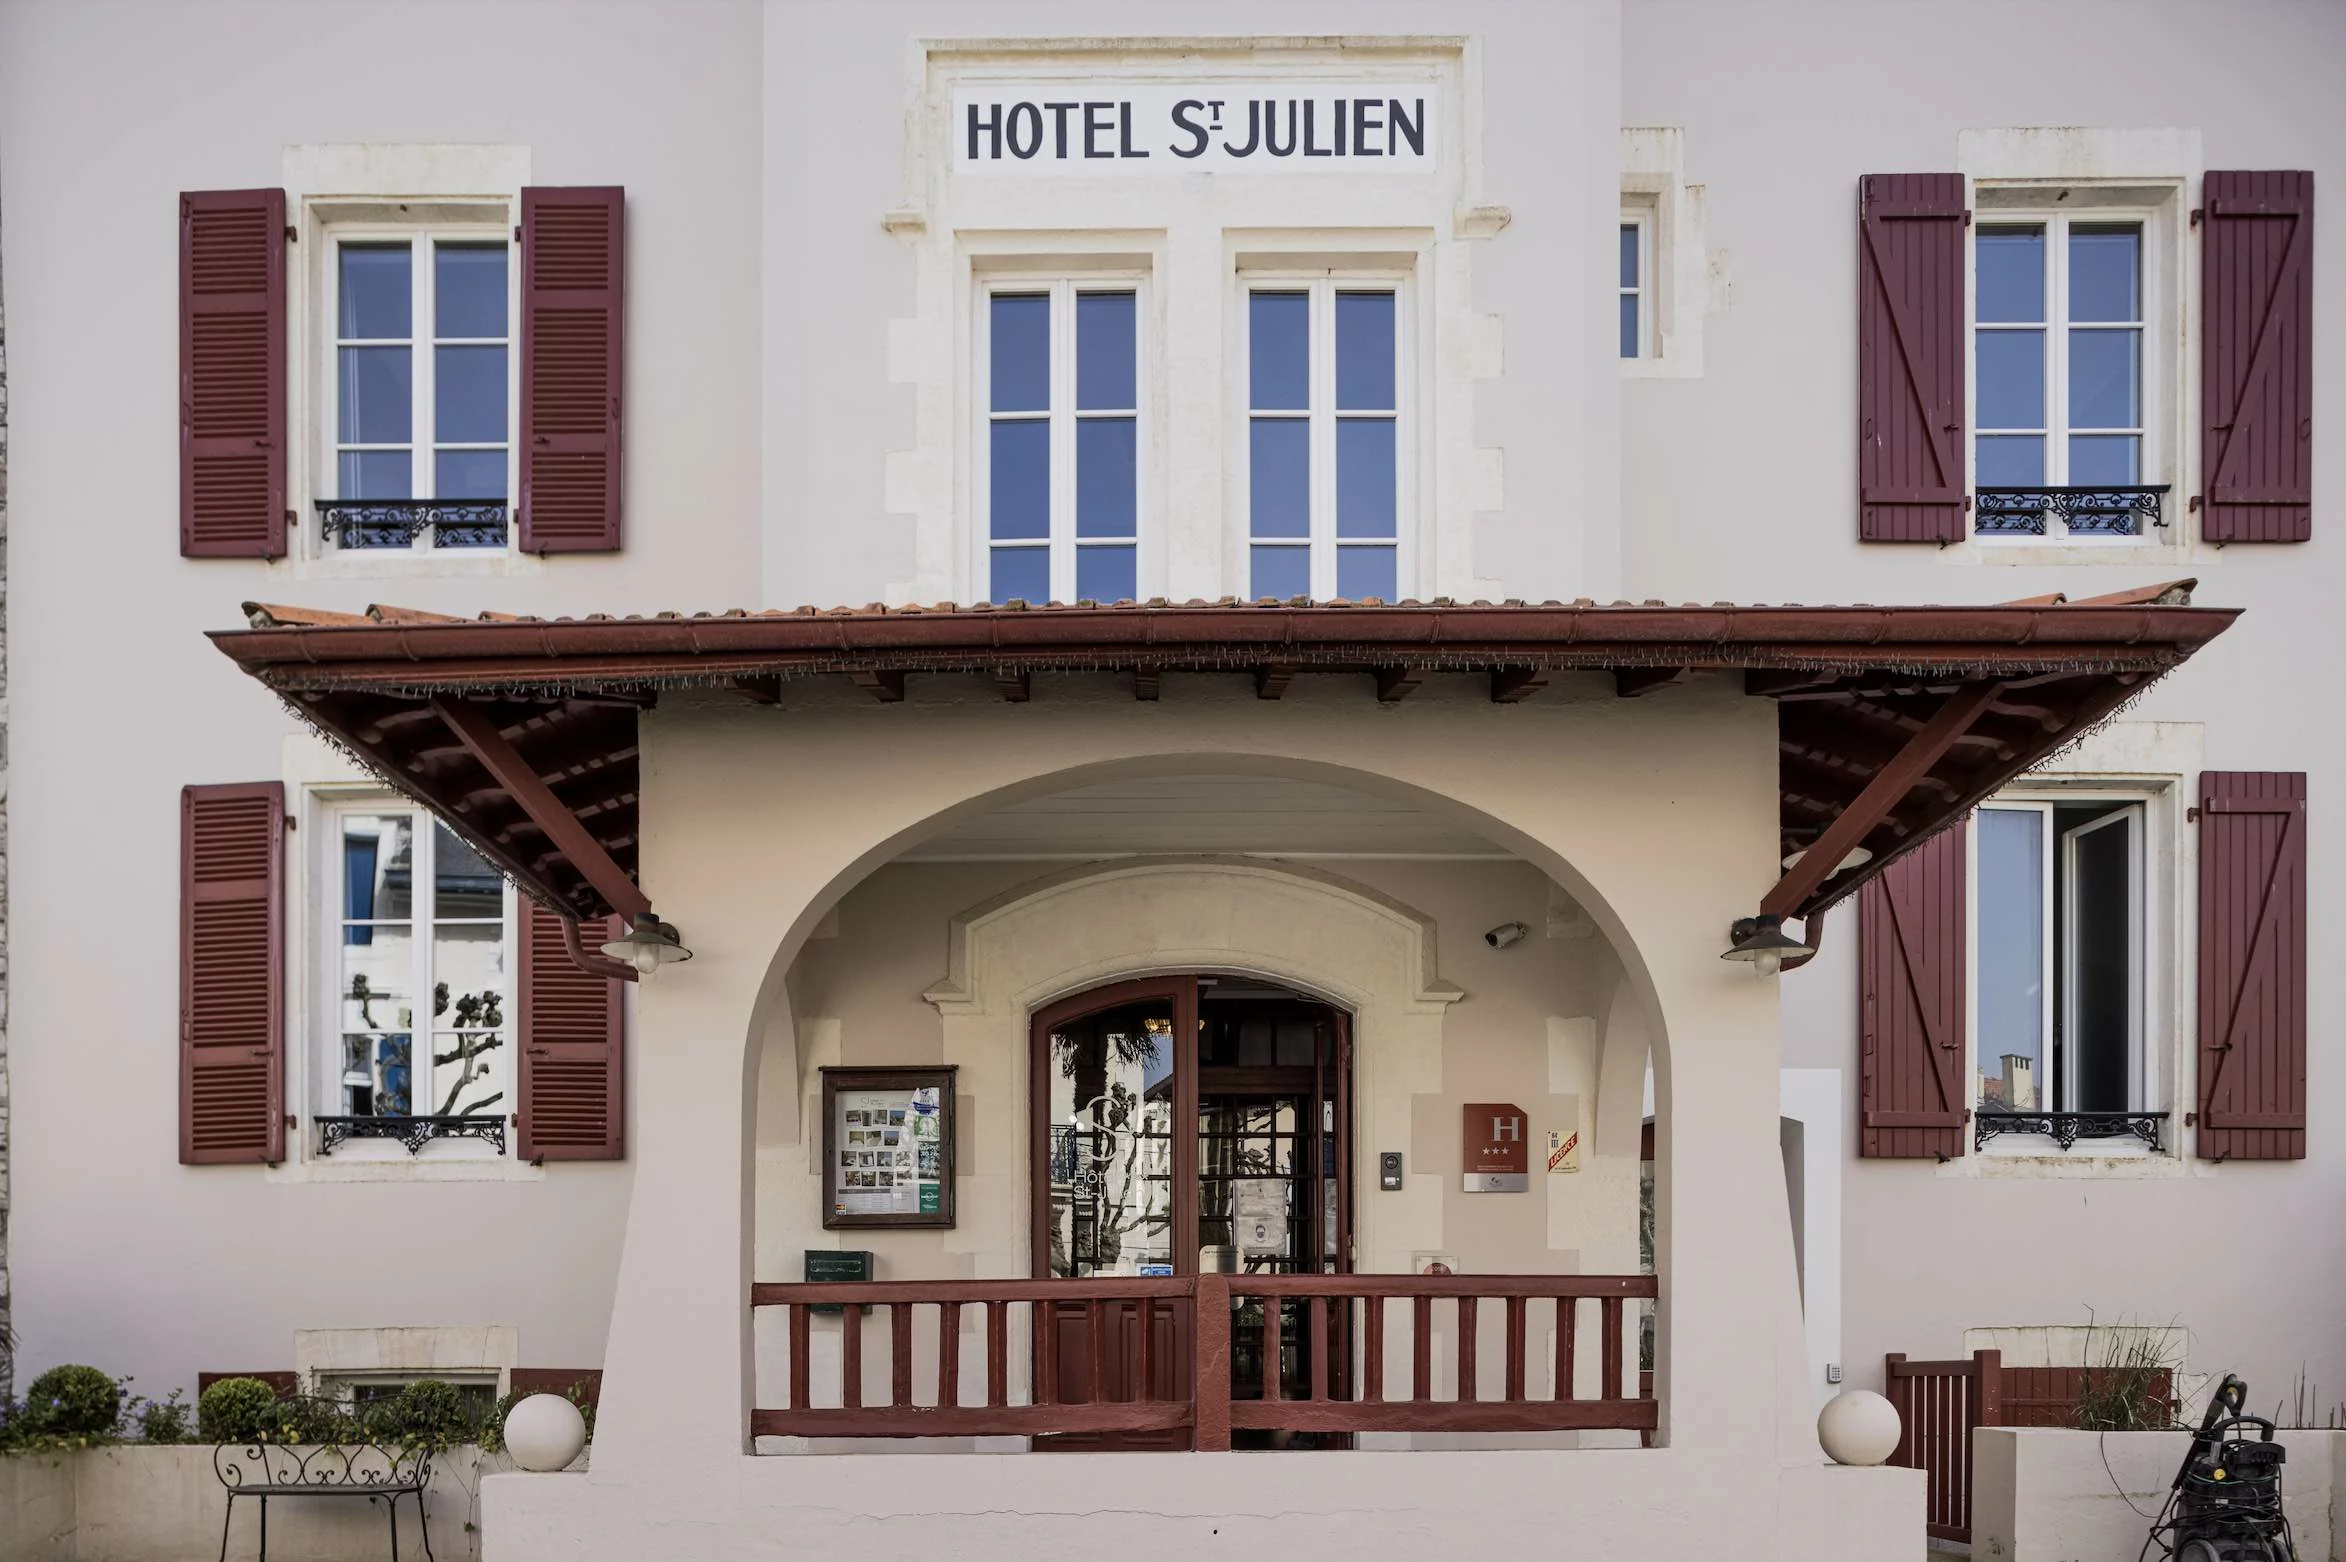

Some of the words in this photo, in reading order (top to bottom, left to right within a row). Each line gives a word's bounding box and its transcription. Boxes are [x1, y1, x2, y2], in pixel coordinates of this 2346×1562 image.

[967, 101, 1150, 160] HOTEL
[1223, 98, 1424, 158] JULIEN
[1492, 1116, 1521, 1142] H
[1550, 1135, 1577, 1167] LICENCE
